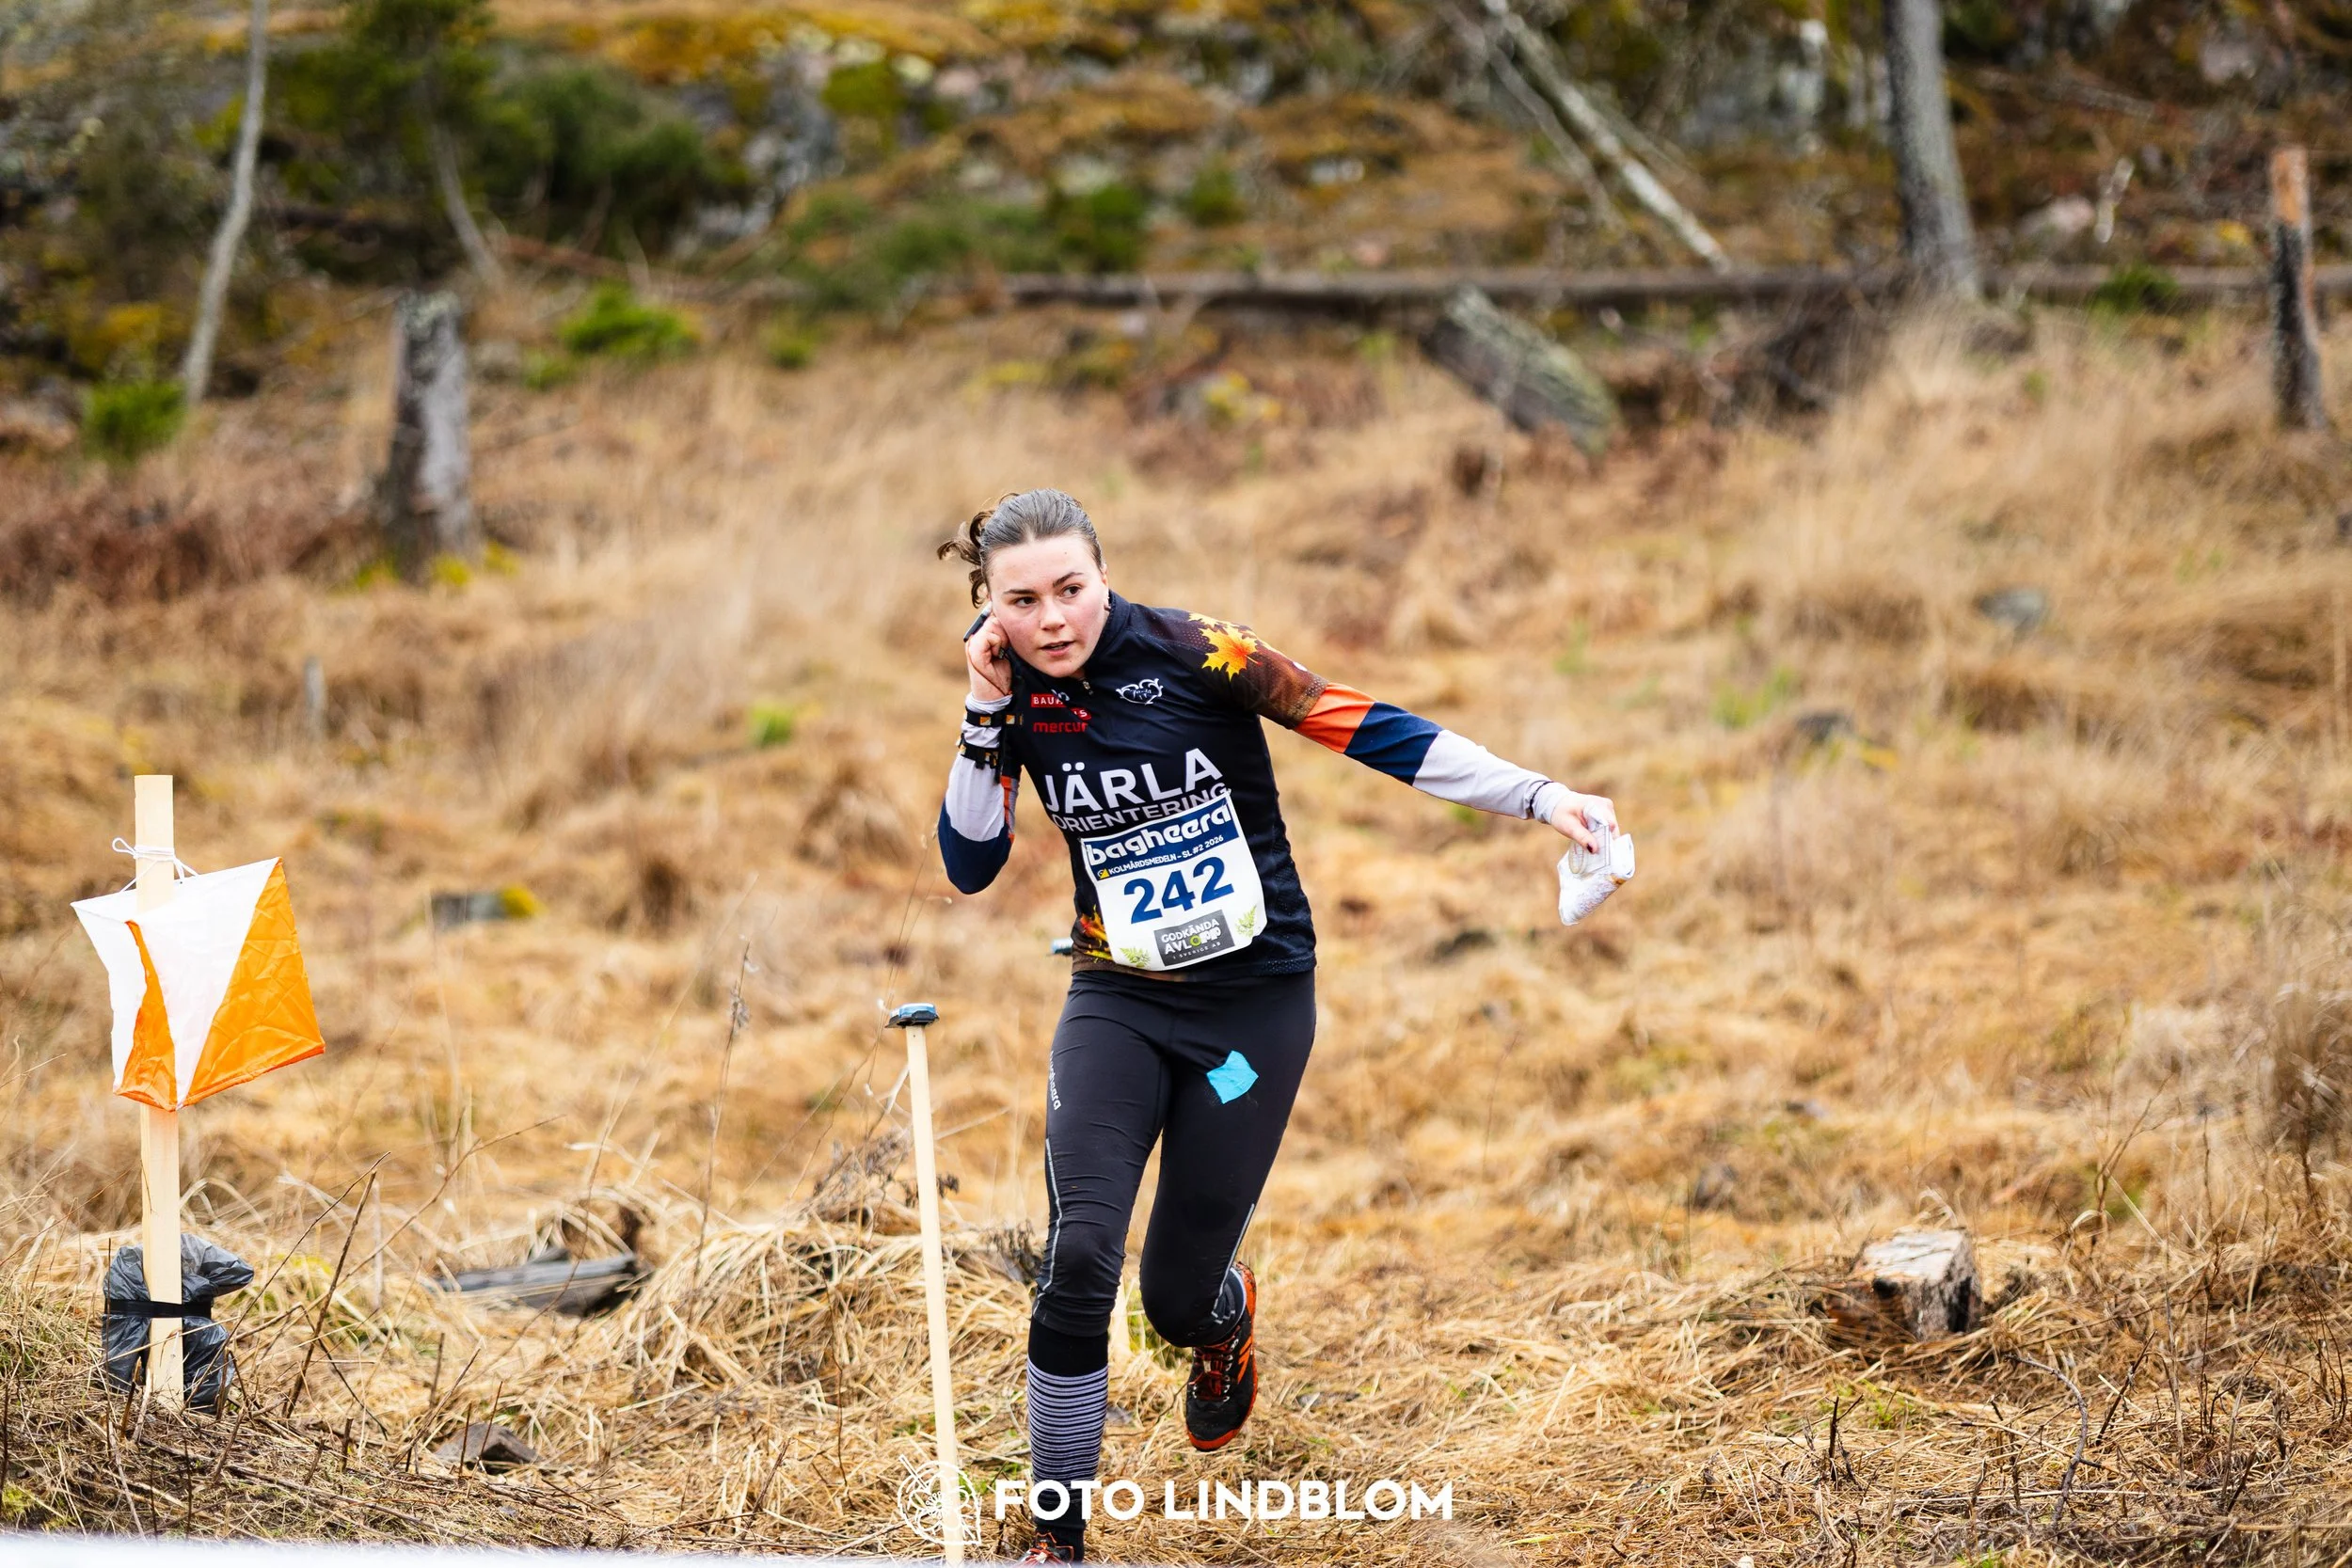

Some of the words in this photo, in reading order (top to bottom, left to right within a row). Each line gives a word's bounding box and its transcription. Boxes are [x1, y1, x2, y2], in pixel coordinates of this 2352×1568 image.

[1044, 748, 1223, 814] JÄRLA
[1052, 783, 1227, 833] ORIENTERING
[1085, 803, 1232, 866] bagheera
[1183, 850, 1192, 859] SL
[1204, 834, 1224, 849] 2026
[1123, 856, 1234, 925] 242
